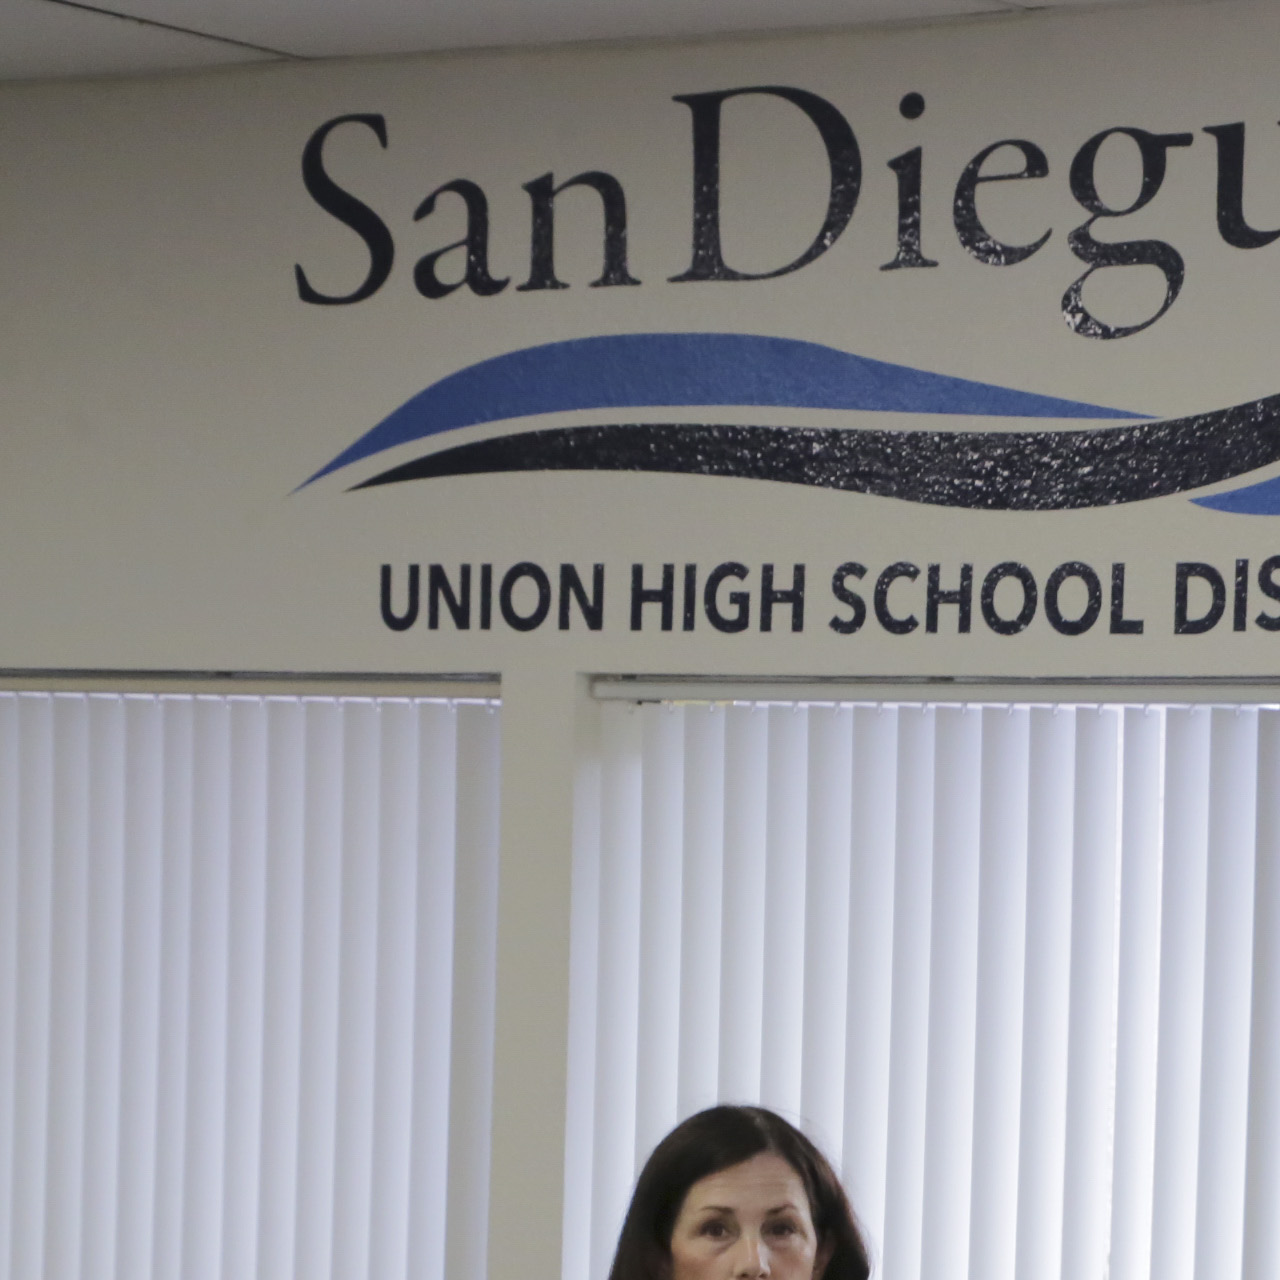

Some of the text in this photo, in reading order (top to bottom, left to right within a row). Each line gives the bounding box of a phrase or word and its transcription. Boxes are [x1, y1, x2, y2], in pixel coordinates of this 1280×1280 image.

[379, 562, 603, 632] UNION
[629, 562, 806, 632] HIGH
[829, 560, 1143, 636] SCHOOL
